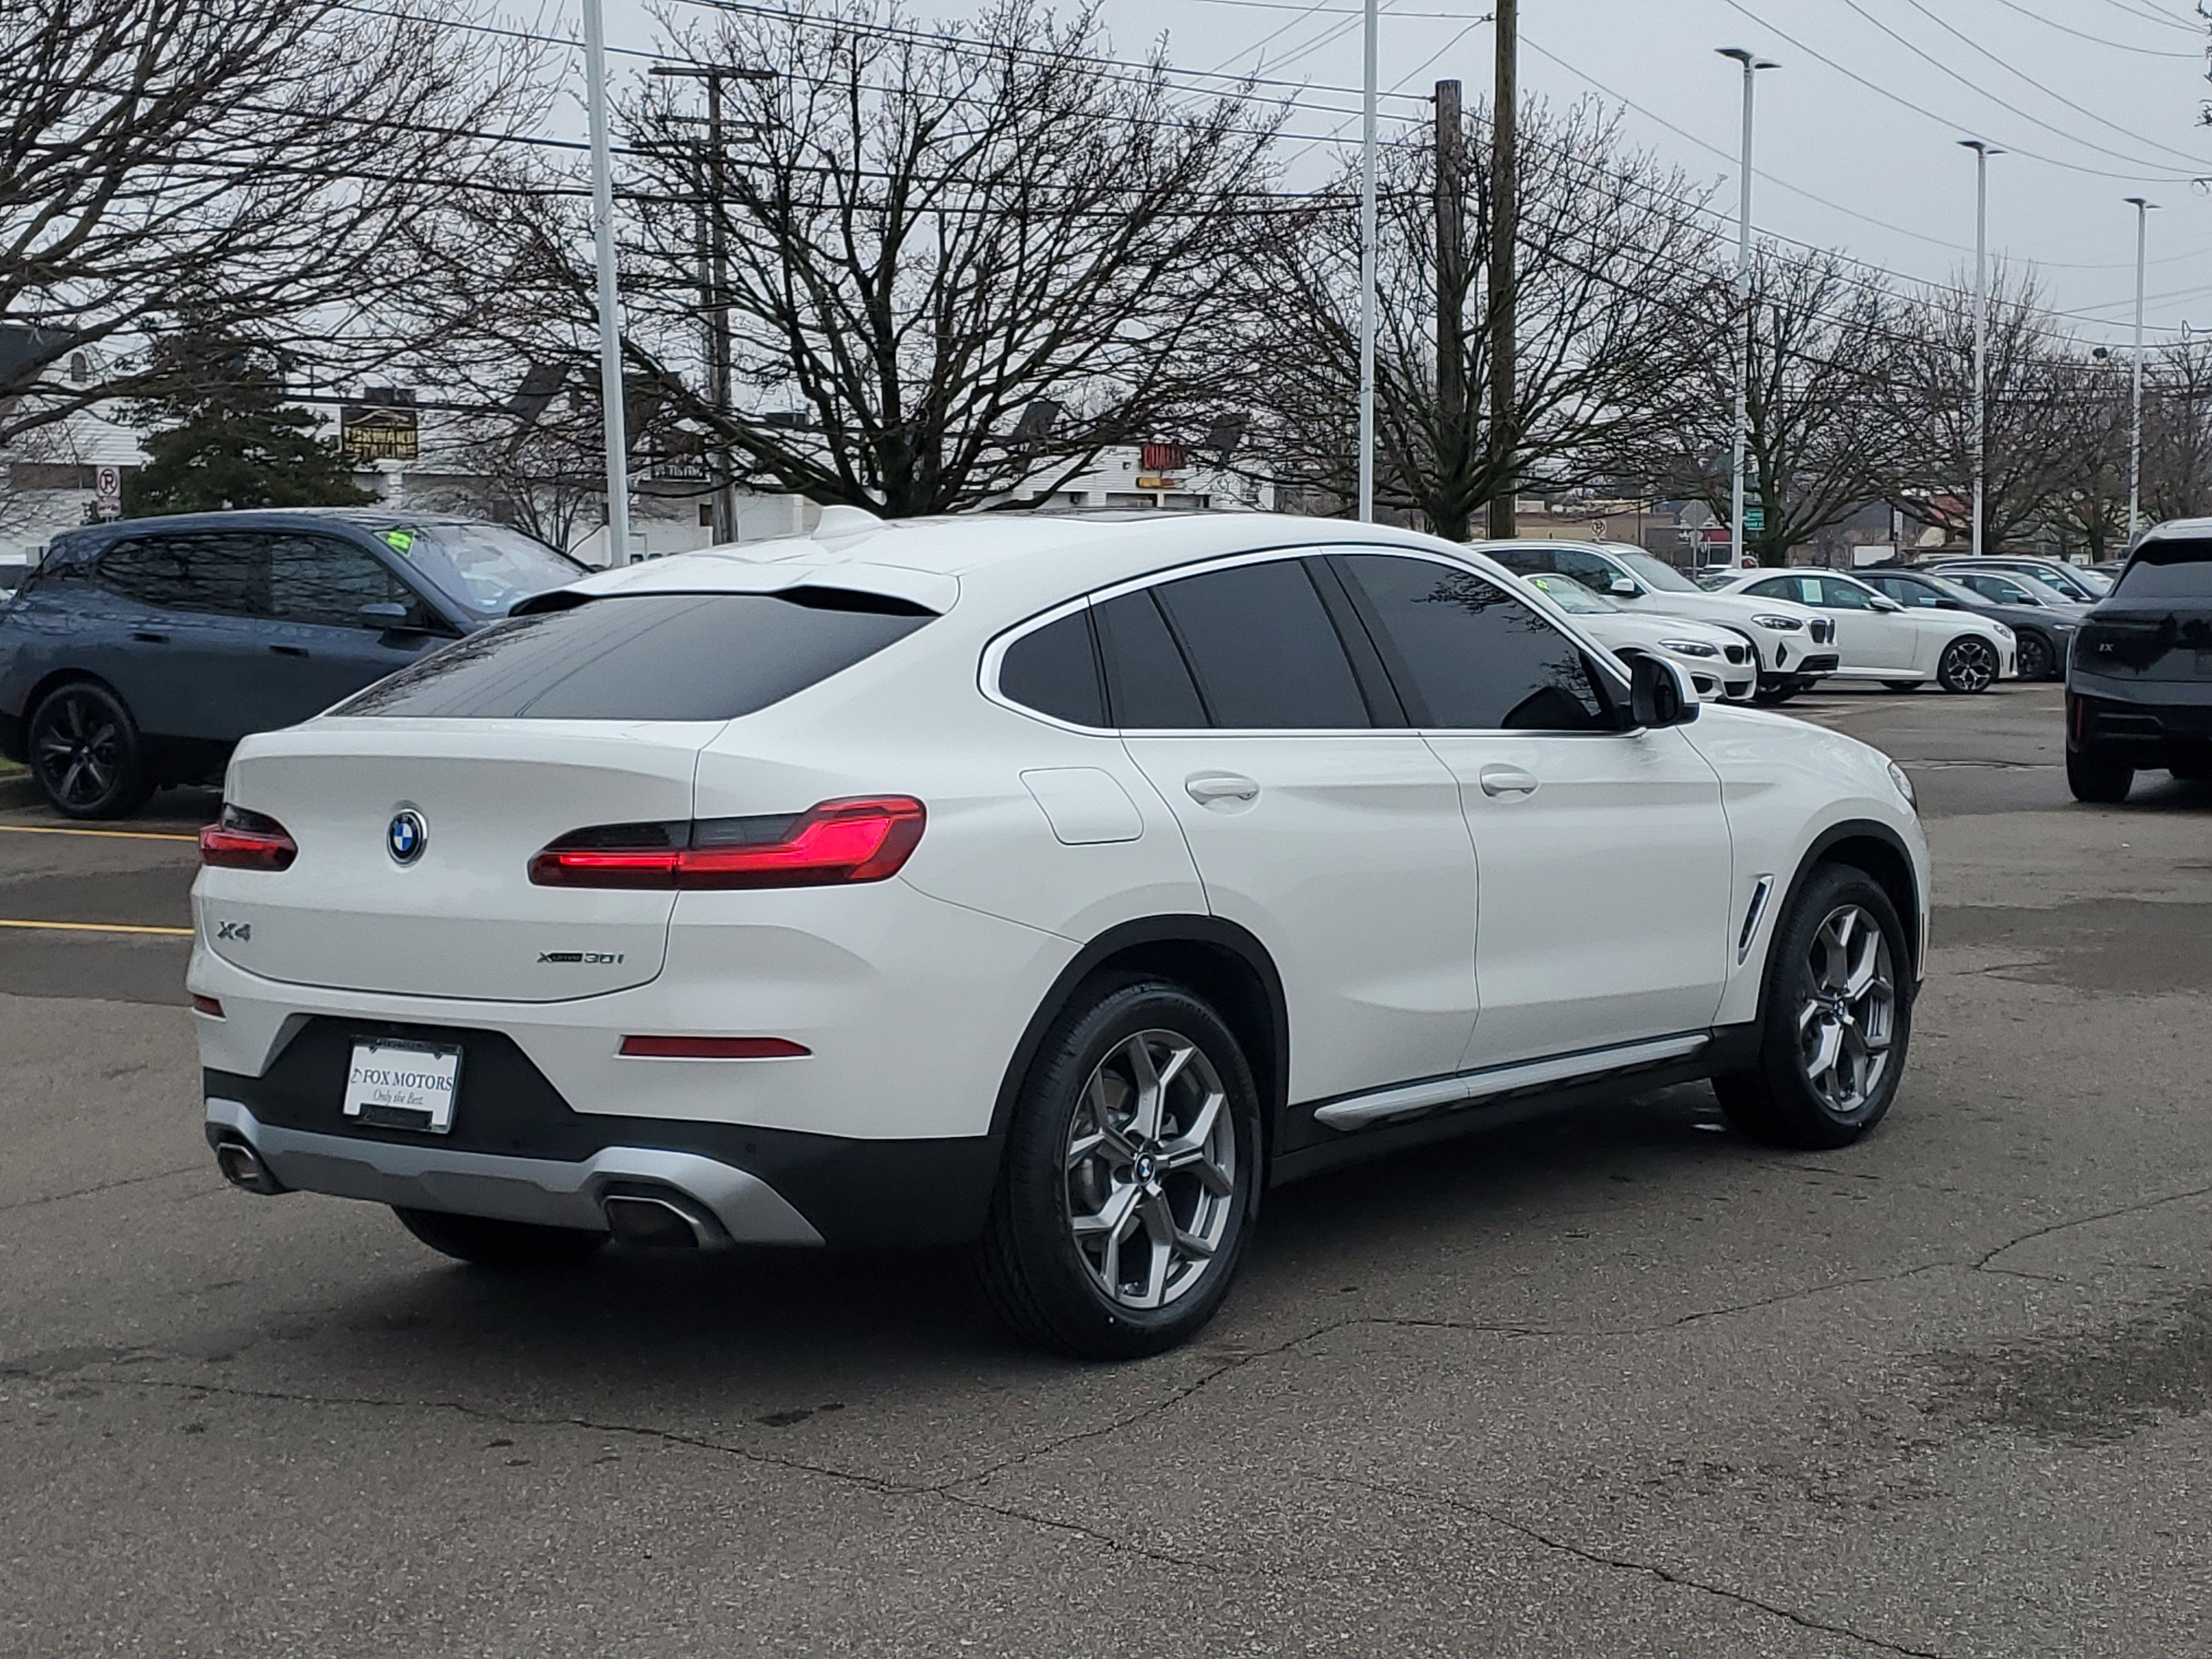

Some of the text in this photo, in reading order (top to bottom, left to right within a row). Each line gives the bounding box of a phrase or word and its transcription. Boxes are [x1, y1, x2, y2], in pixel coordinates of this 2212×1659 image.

[217, 922, 251, 942] X4
[363, 1069, 453, 1091] FOX MOTORS
[374, 1088, 392, 1106] Only
[393, 1091, 405, 1103] the
